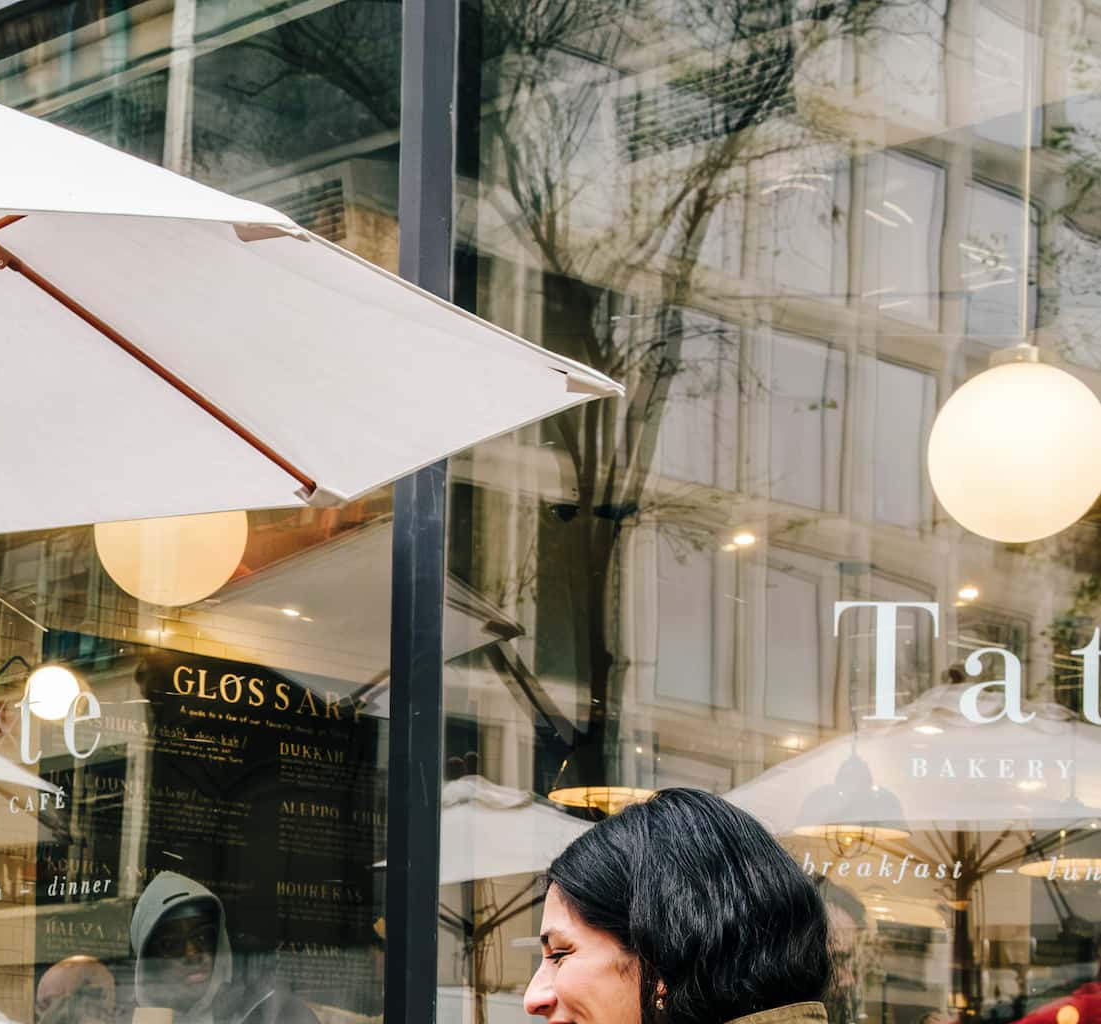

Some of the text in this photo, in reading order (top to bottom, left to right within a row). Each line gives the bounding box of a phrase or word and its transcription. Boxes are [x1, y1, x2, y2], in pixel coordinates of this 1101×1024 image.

[173, 664, 367, 723] GLOSSARY
[911, 757, 1075, 780] BAKERY
[9, 785, 66, 814] CAFÉ
[801, 853, 964, 885] breakfast
[47, 876, 113, 898] dinner
